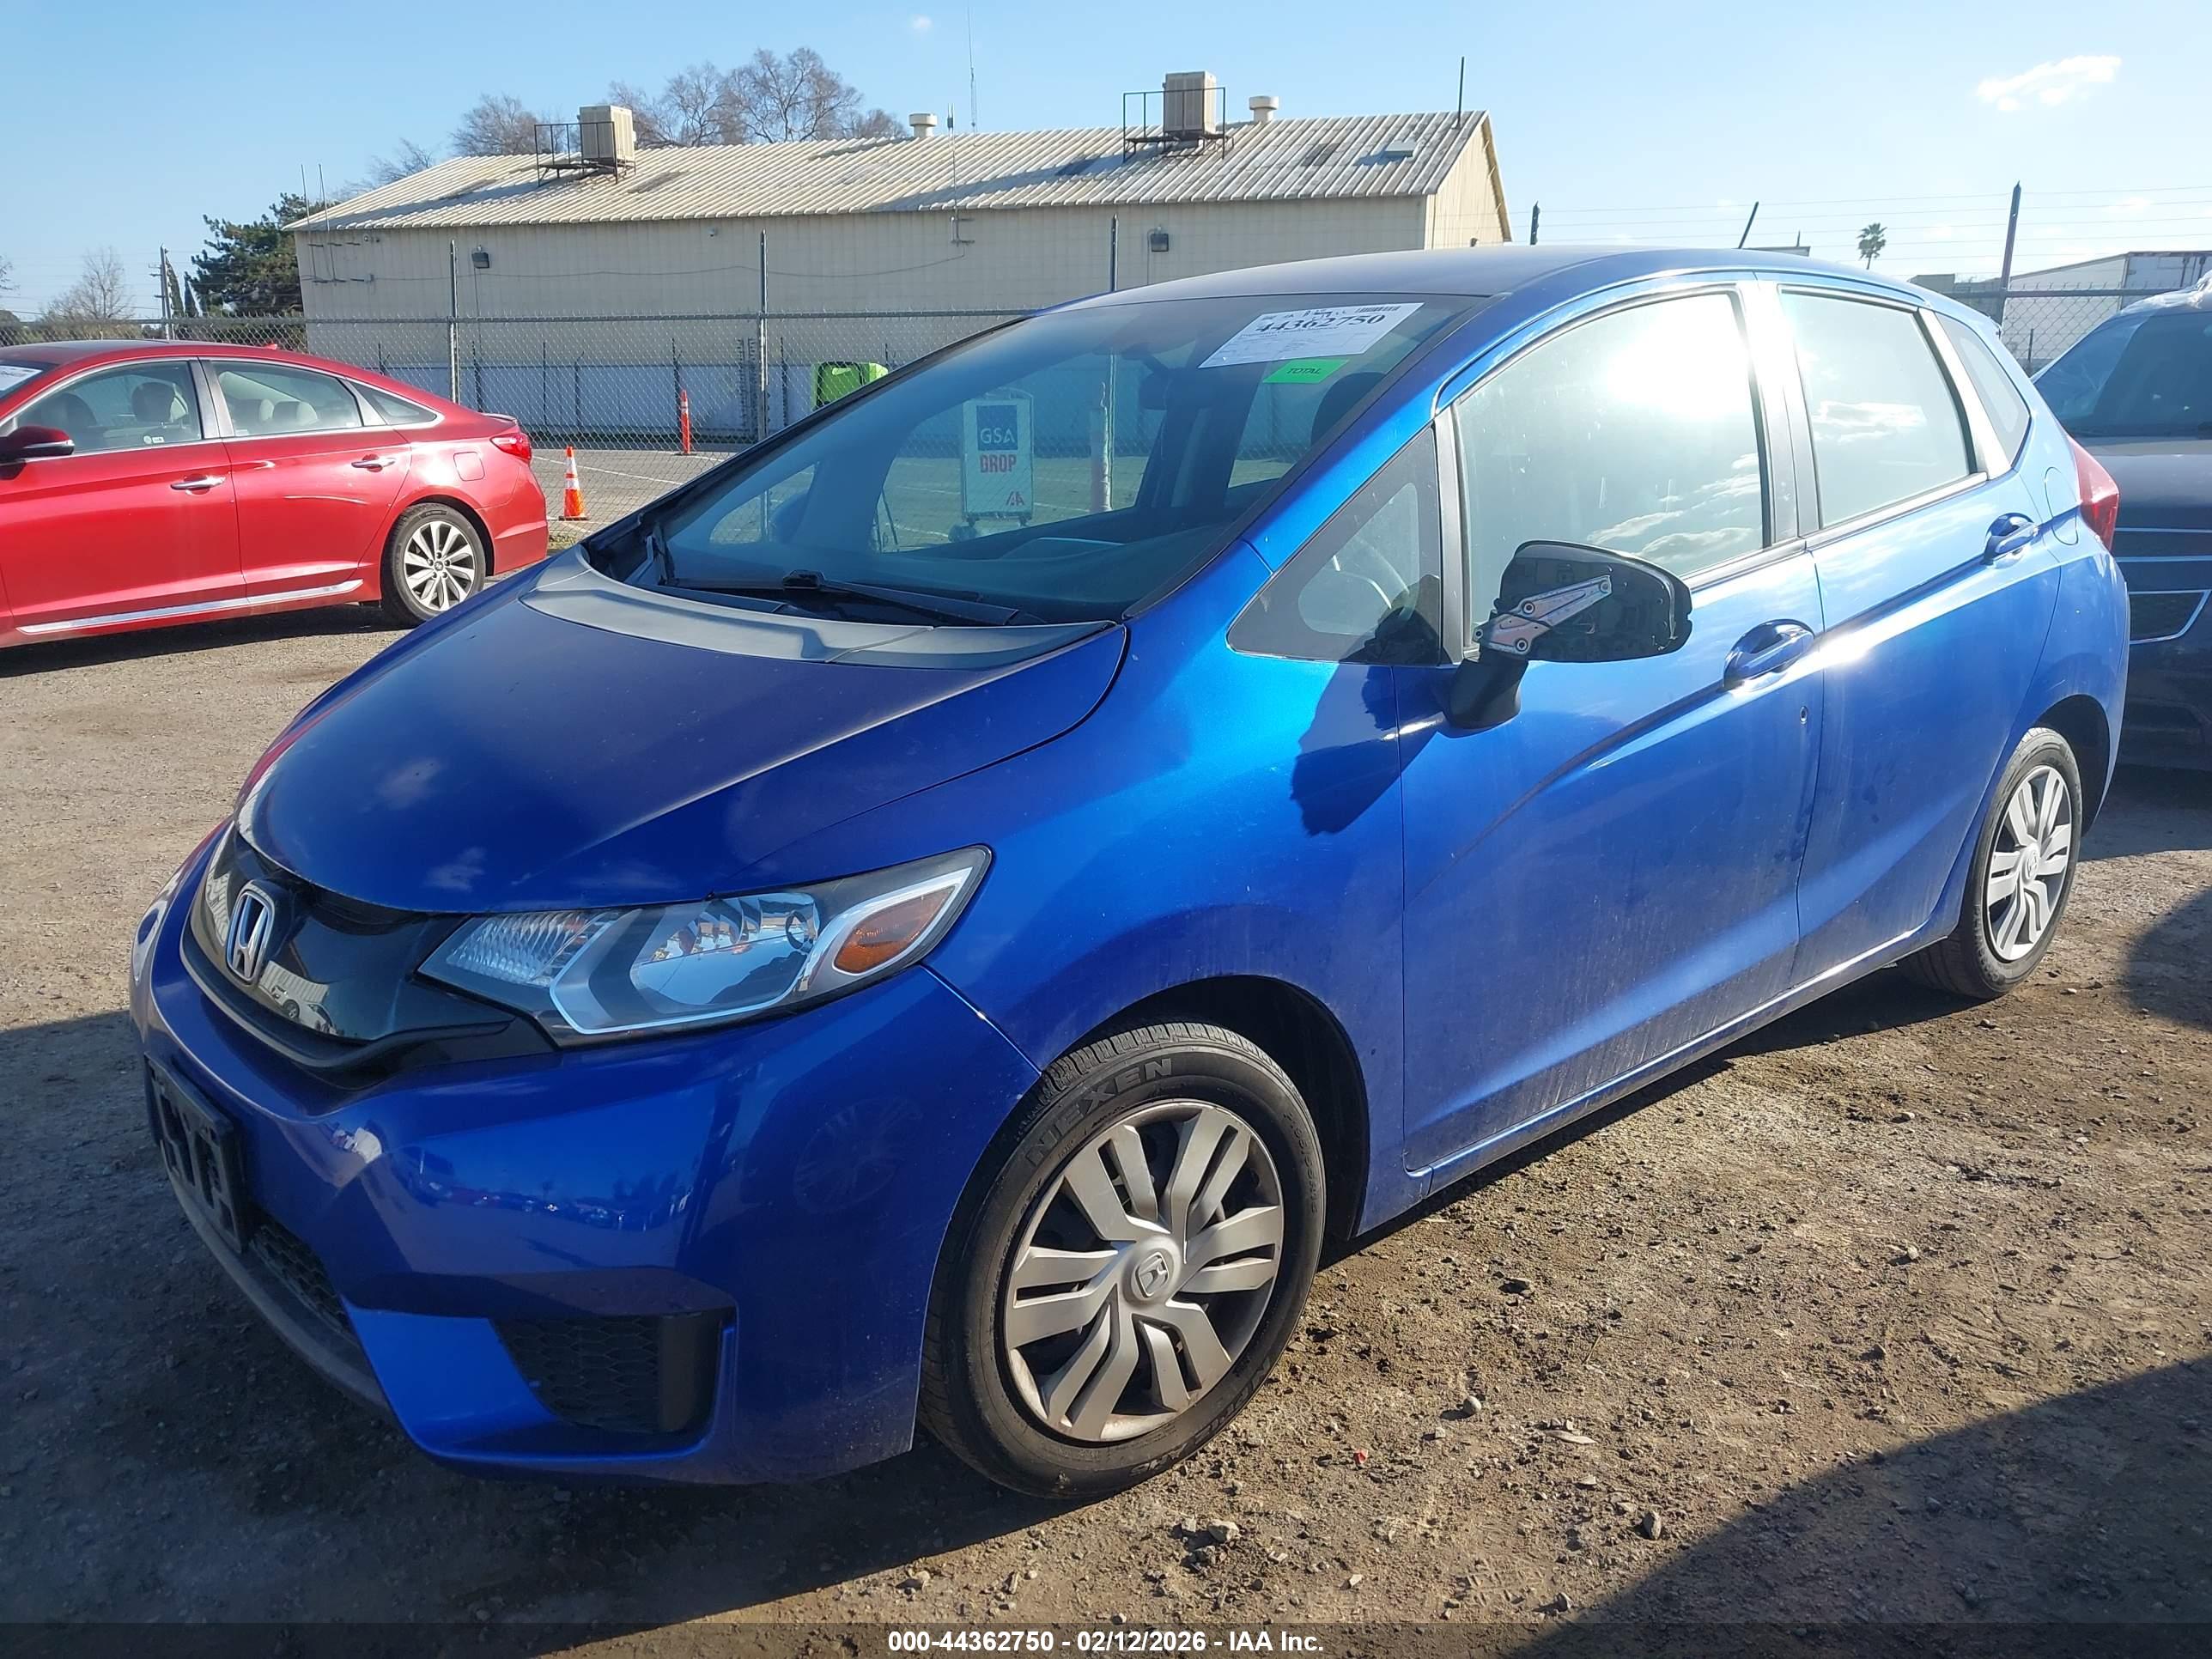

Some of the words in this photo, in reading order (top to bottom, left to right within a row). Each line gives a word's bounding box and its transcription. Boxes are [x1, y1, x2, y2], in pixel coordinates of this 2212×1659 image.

[1255, 314, 1385, 332] 44362750
[980, 428, 1015, 444] GSA
[980, 454, 1017, 473] DROP
[1025, 1058, 1172, 1168] NEXEN
